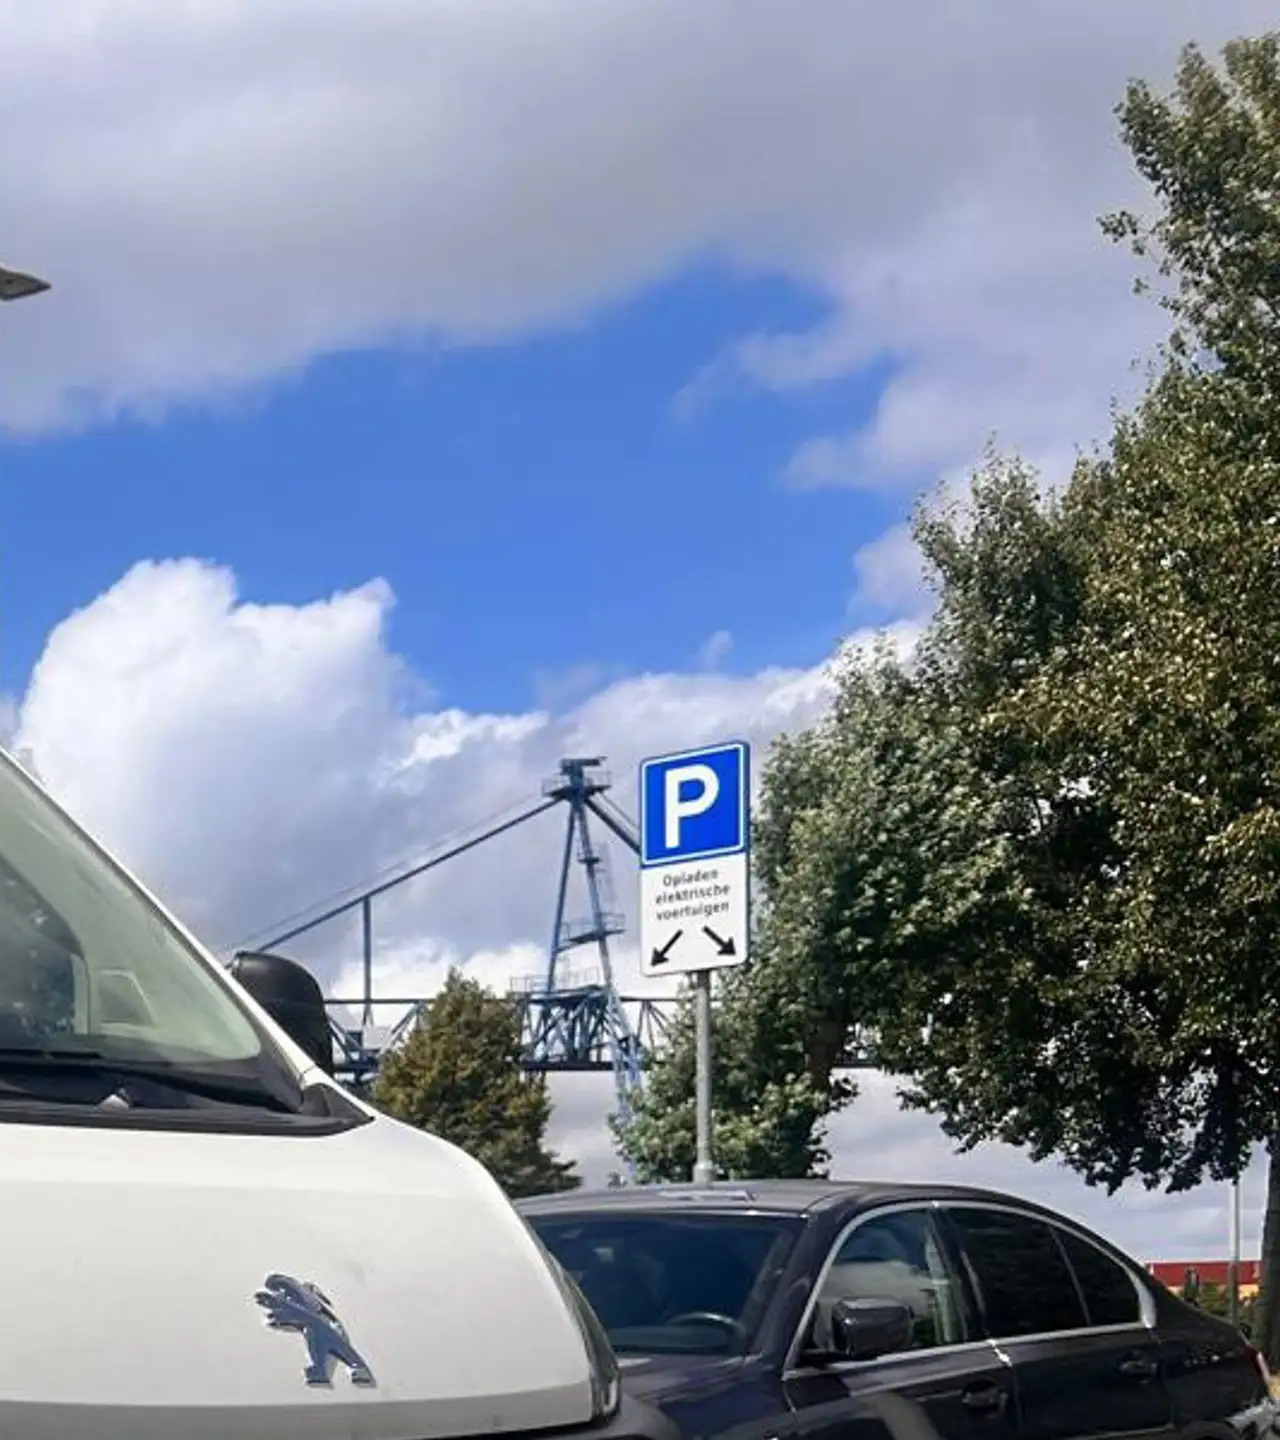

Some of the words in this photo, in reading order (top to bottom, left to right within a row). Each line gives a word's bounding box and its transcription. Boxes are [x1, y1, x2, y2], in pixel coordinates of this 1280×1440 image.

[664, 764, 720, 849] P
[662, 869, 719, 889] Opladen
[655, 884, 731, 904] elektrische
[656, 901, 730, 920] voertuigen
